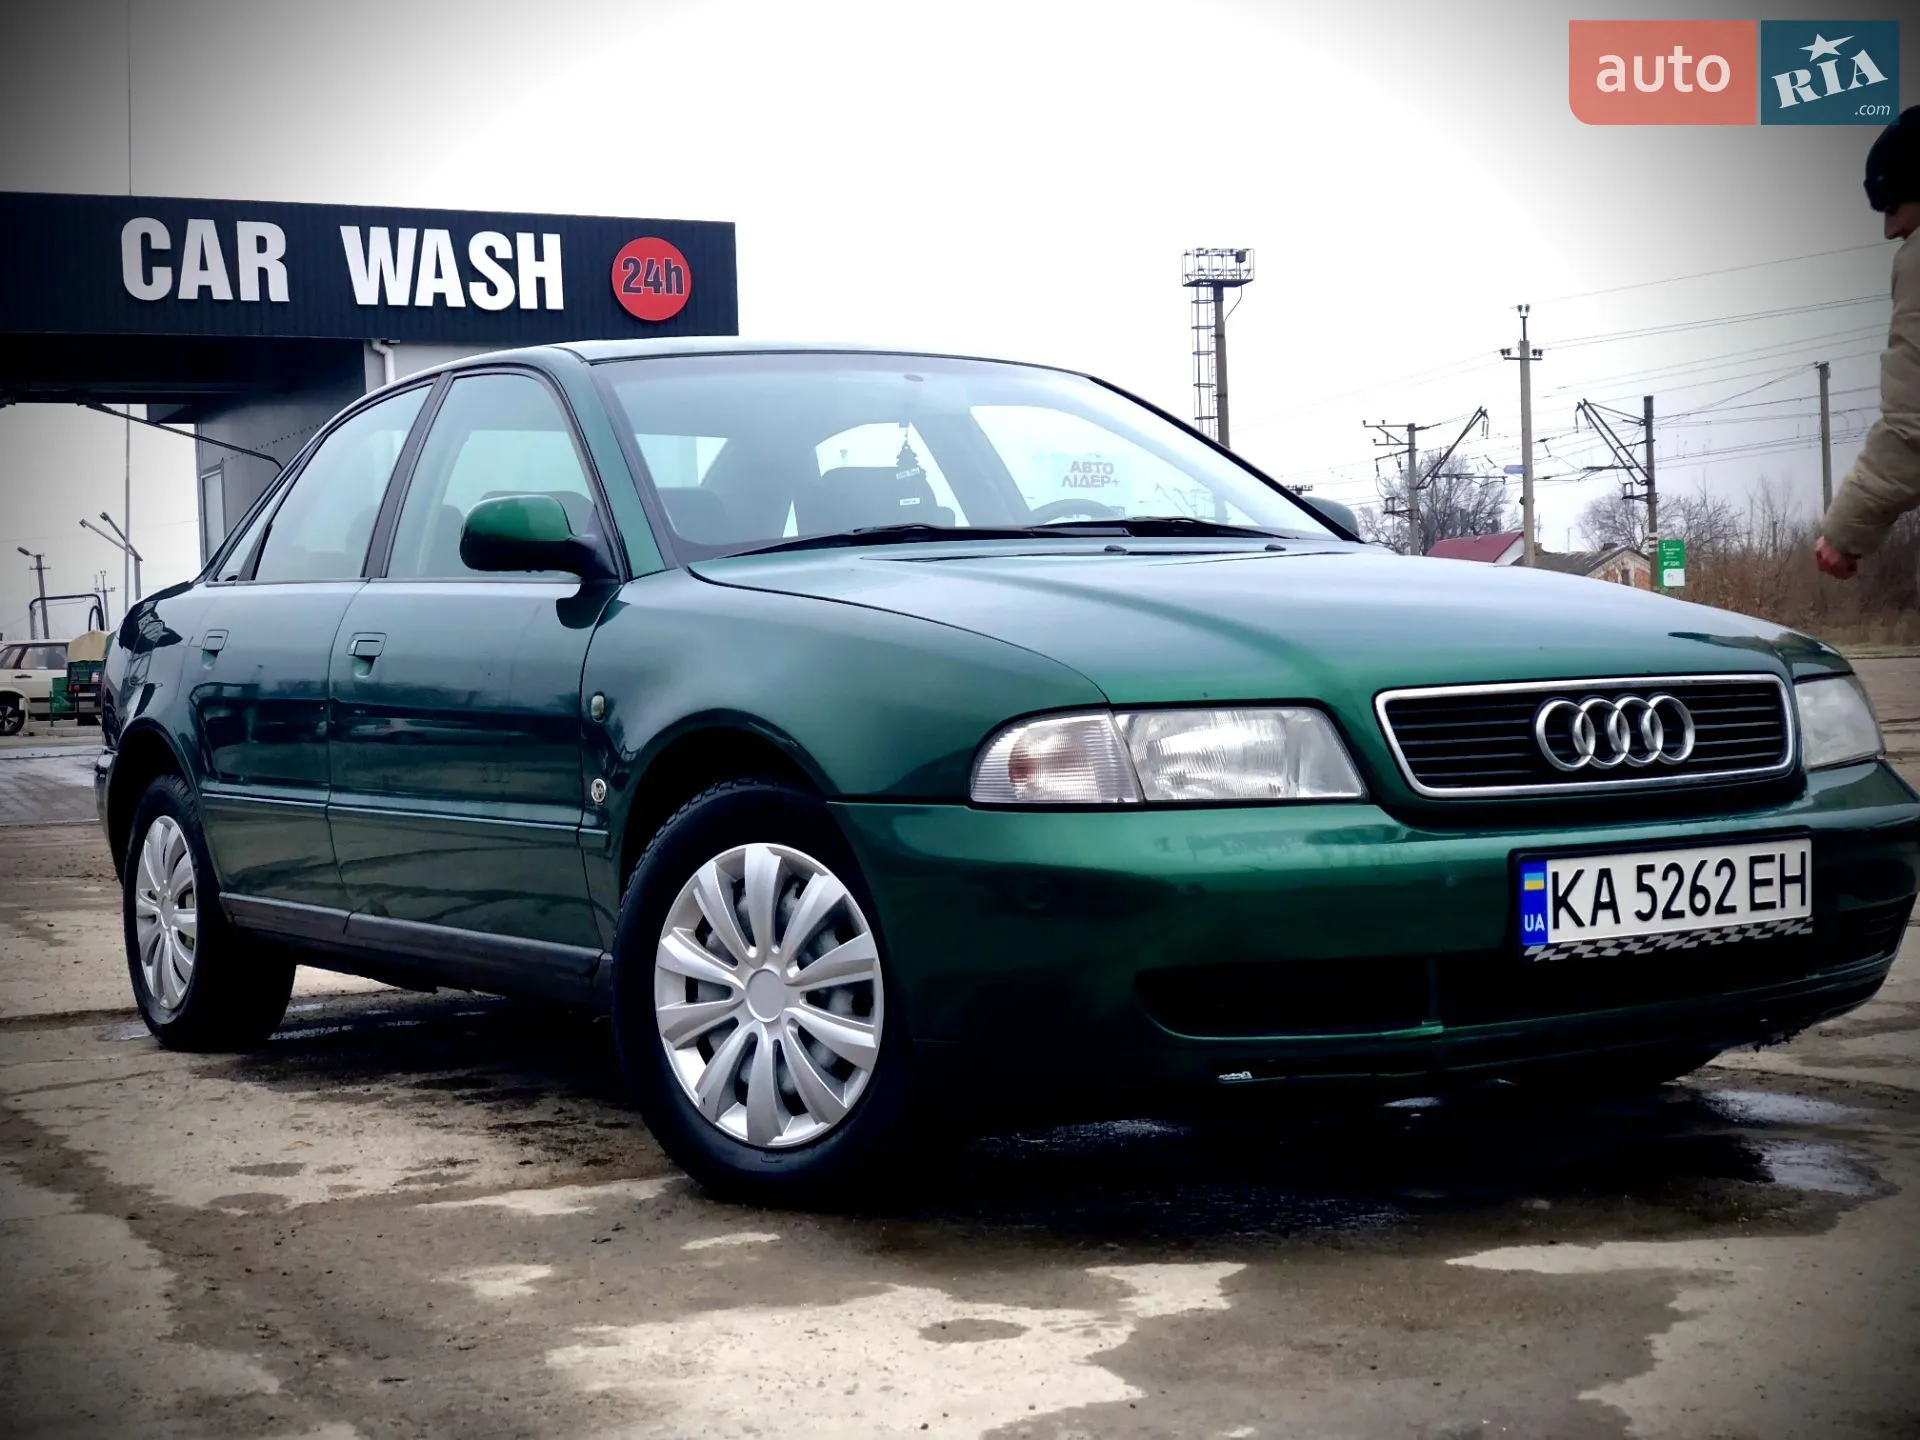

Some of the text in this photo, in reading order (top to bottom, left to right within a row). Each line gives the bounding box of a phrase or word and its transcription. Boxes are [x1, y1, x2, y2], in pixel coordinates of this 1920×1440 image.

[121, 217, 564, 311] CAR WASH
[622, 256, 685, 296] 24h
[1070, 460, 1115, 475] АВТО
[1551, 850, 1807, 930] KA 5262 EH
[1524, 913, 1546, 932] UA
